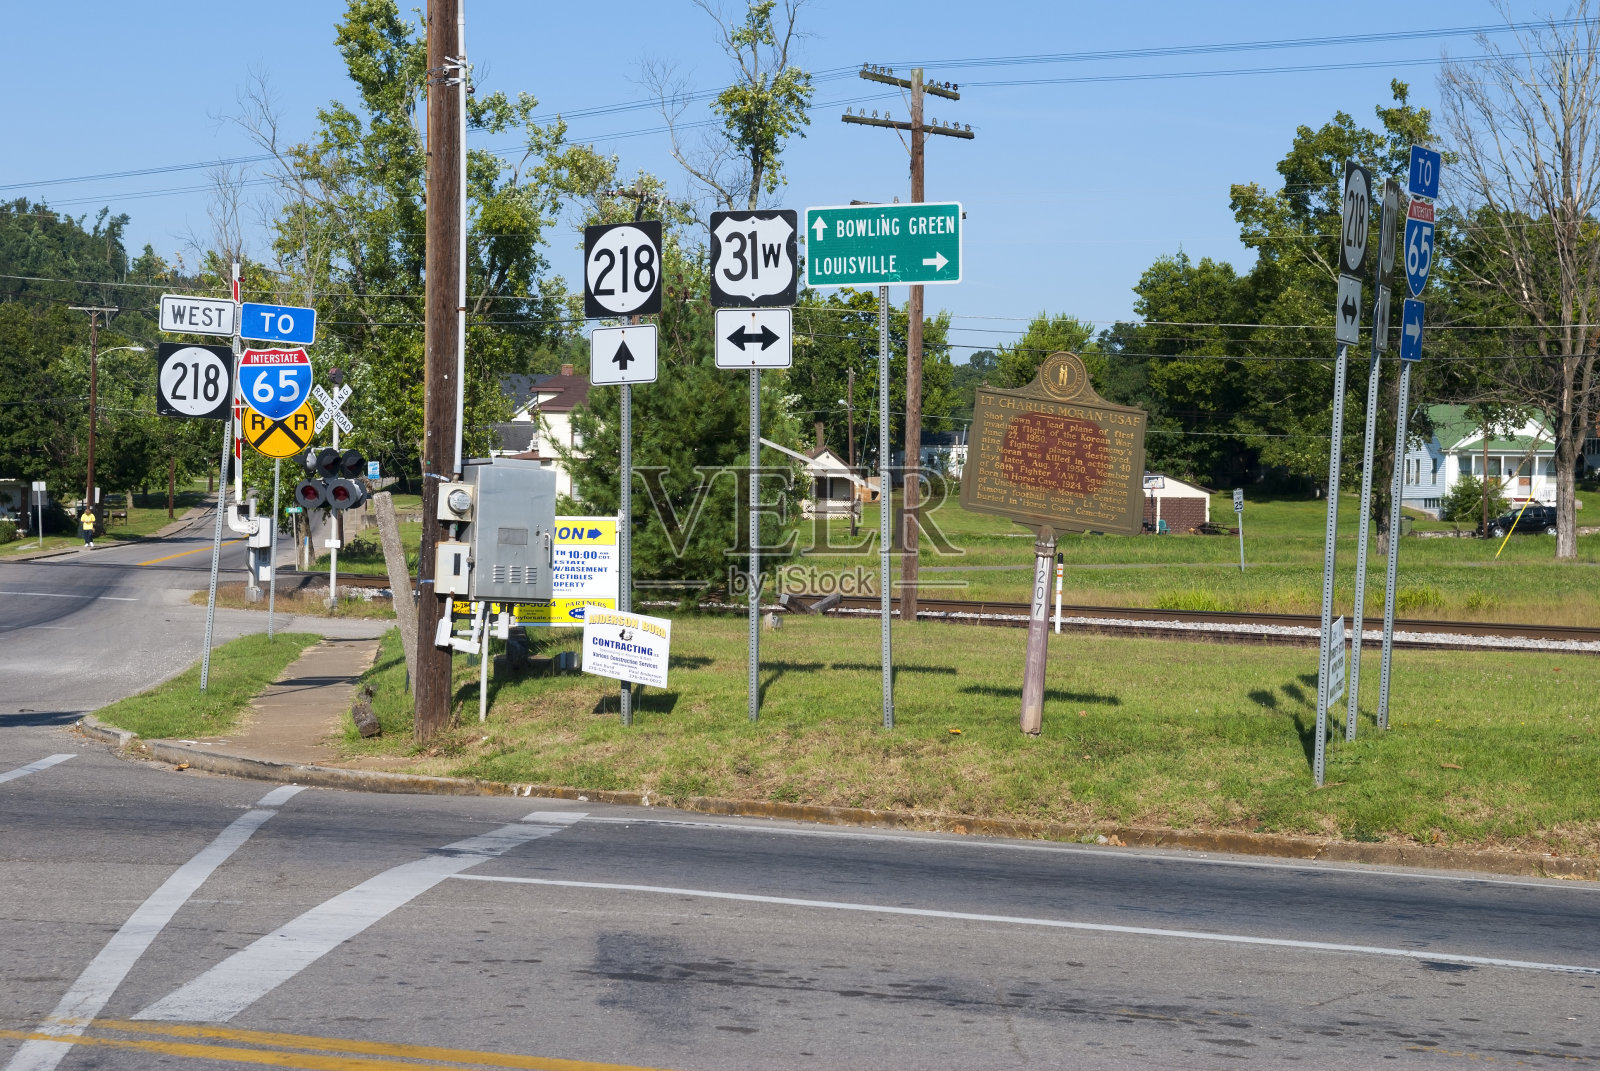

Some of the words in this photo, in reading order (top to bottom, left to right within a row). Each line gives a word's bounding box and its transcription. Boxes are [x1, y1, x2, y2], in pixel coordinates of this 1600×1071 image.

[1418, 158, 1432, 187] TO
[1346, 190, 1365, 249] 218
[1412, 204, 1433, 220] INTERSTATE
[836, 217, 900, 238] BOWLING
[909, 216, 955, 235] GREEN
[1408, 226, 1432, 277] 65
[593, 244, 656, 297] 218
[815, 255, 897, 276] LOUISVILLE
[171, 304, 225, 328] WEST
[260, 312, 294, 334] TO
[250, 354, 299, 364] INTERSTATE
[171, 362, 220, 402] 218
[252, 370, 300, 402] 65
[314, 387, 328, 406] RAIL
[334, 412, 351, 432] ROAD
[316, 388, 348, 430] CROSSING
[981, 396, 995, 406] LT.
[999, 398, 1054, 415] CHARLES
[1058, 406, 1141, 427] MORAN-USAF
[251, 414, 266, 430] R
[294, 414, 308, 430] R
[984, 411, 1004, 420] Shot
[1009, 416, 1030, 424] down
[1047, 420, 1064, 430] lead
[1070, 425, 1093, 434] plane
[1098, 428, 1108, 436] of
[1114, 430, 1134, 440] first
[984, 420, 1018, 432] invading
[1022, 425, 1046, 436] flight
[1063, 432, 1077, 440] the
[1080, 434, 1111, 445] Korean
[982, 428, 1003, 436] June
[1057, 438, 1077, 448] Four
[1098, 446, 1132, 456] enemy's
[1010, 440, 1038, 450] fighter
[1049, 446, 1076, 456] planes
[980, 452, 1000, 460] days
[1096, 468, 1130, 480] Member
[996, 446, 1022, 456] Moran
[1046, 453, 1070, 464] killed
[1074, 458, 1083, 466] in
[1087, 461, 1114, 470] action
[1120, 464, 1131, 472] 40
[978, 476, 988, 484] of
[979, 468, 998, 478] Born
[1012, 472, 1035, 482] Horse
[1088, 484, 1128, 496] Grandson
[995, 462, 1014, 472] 68th
[1020, 466, 1052, 476] Fighter
[1058, 472, 1078, 480] (AW)
[1084, 475, 1129, 489] Squadron.
[976, 492, 1004, 502] buried
[1022, 500, 1046, 509] Horse
[1052, 504, 1071, 512] Cave
[978, 484, 1008, 495] famous
[1012, 489, 1045, 500] football
[1100, 502, 1126, 513] Moran
[1234, 501, 1242, 510] 25
[568, 550, 598, 560] 10:00
[1035, 558, 1046, 616] 1207
[566, 600, 606, 608] PARTNERS
[588, 614, 640, 630] ANDERSON
[592, 636, 653, 656] CONTRACTING
[593, 652, 608, 660] Various
[610, 654, 638, 666] Construction
[639, 660, 658, 670] Services
